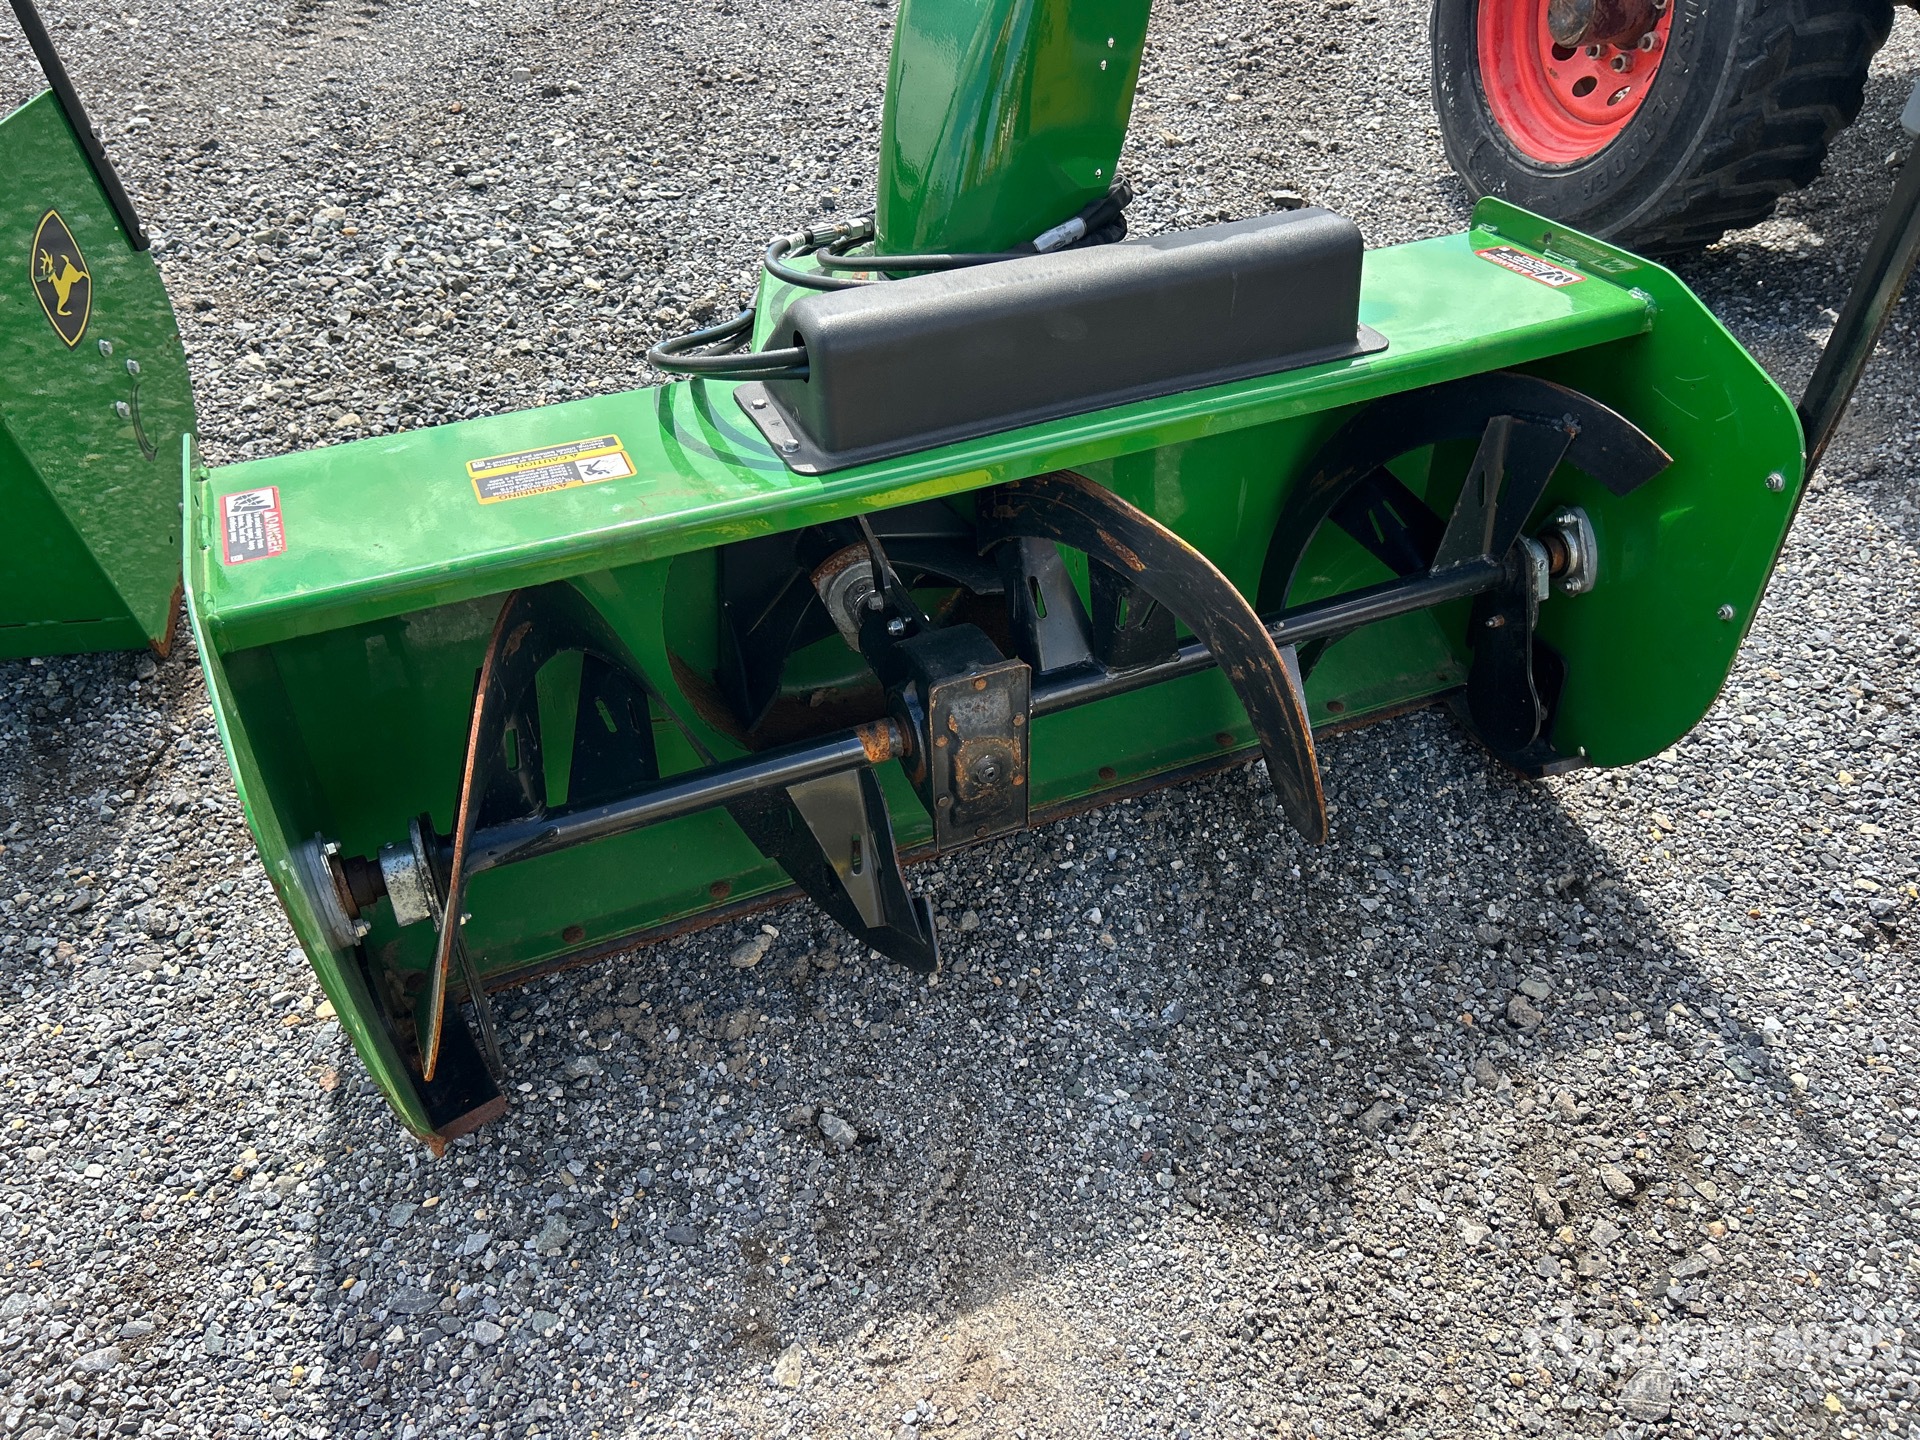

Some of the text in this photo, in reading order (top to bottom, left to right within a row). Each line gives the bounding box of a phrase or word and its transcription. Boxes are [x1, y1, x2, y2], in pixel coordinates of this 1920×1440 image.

[514, 455, 567, 468] CAUTION
[498, 484, 556, 501] WARNING
[263, 516, 283, 553] DANGER
